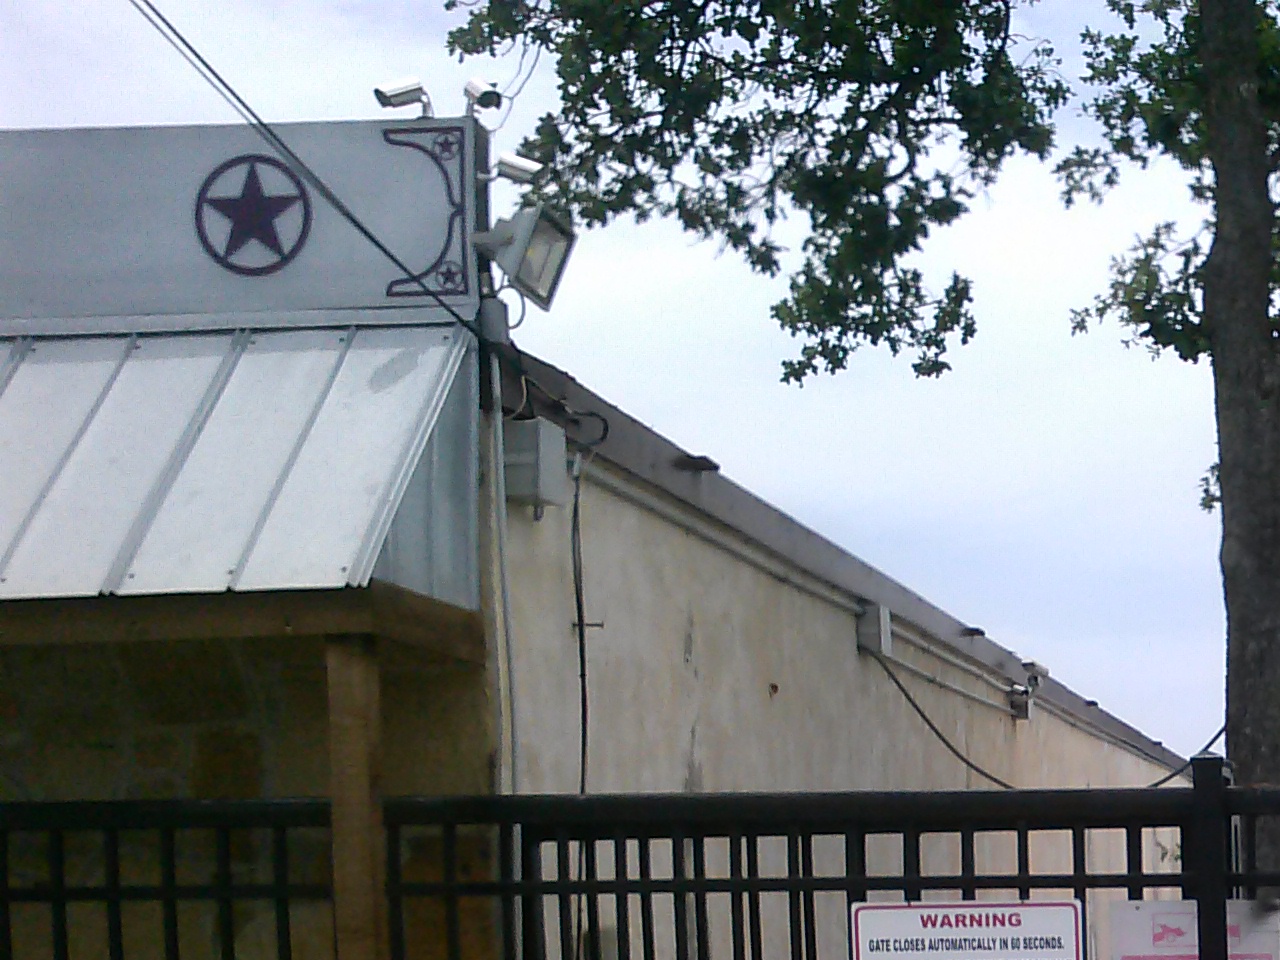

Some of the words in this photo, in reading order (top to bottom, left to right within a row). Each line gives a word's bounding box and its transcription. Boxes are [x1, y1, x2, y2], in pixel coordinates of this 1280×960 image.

[920, 912, 1022, 928] WARNING
[868, 938, 891, 952] GATE
[893, 938, 926, 952] CLOSES
[928, 937, 997, 951] AUTOMATICALLY
[999, 937, 1009, 950] IN
[1023, 936, 1064, 950] SECONDS.
